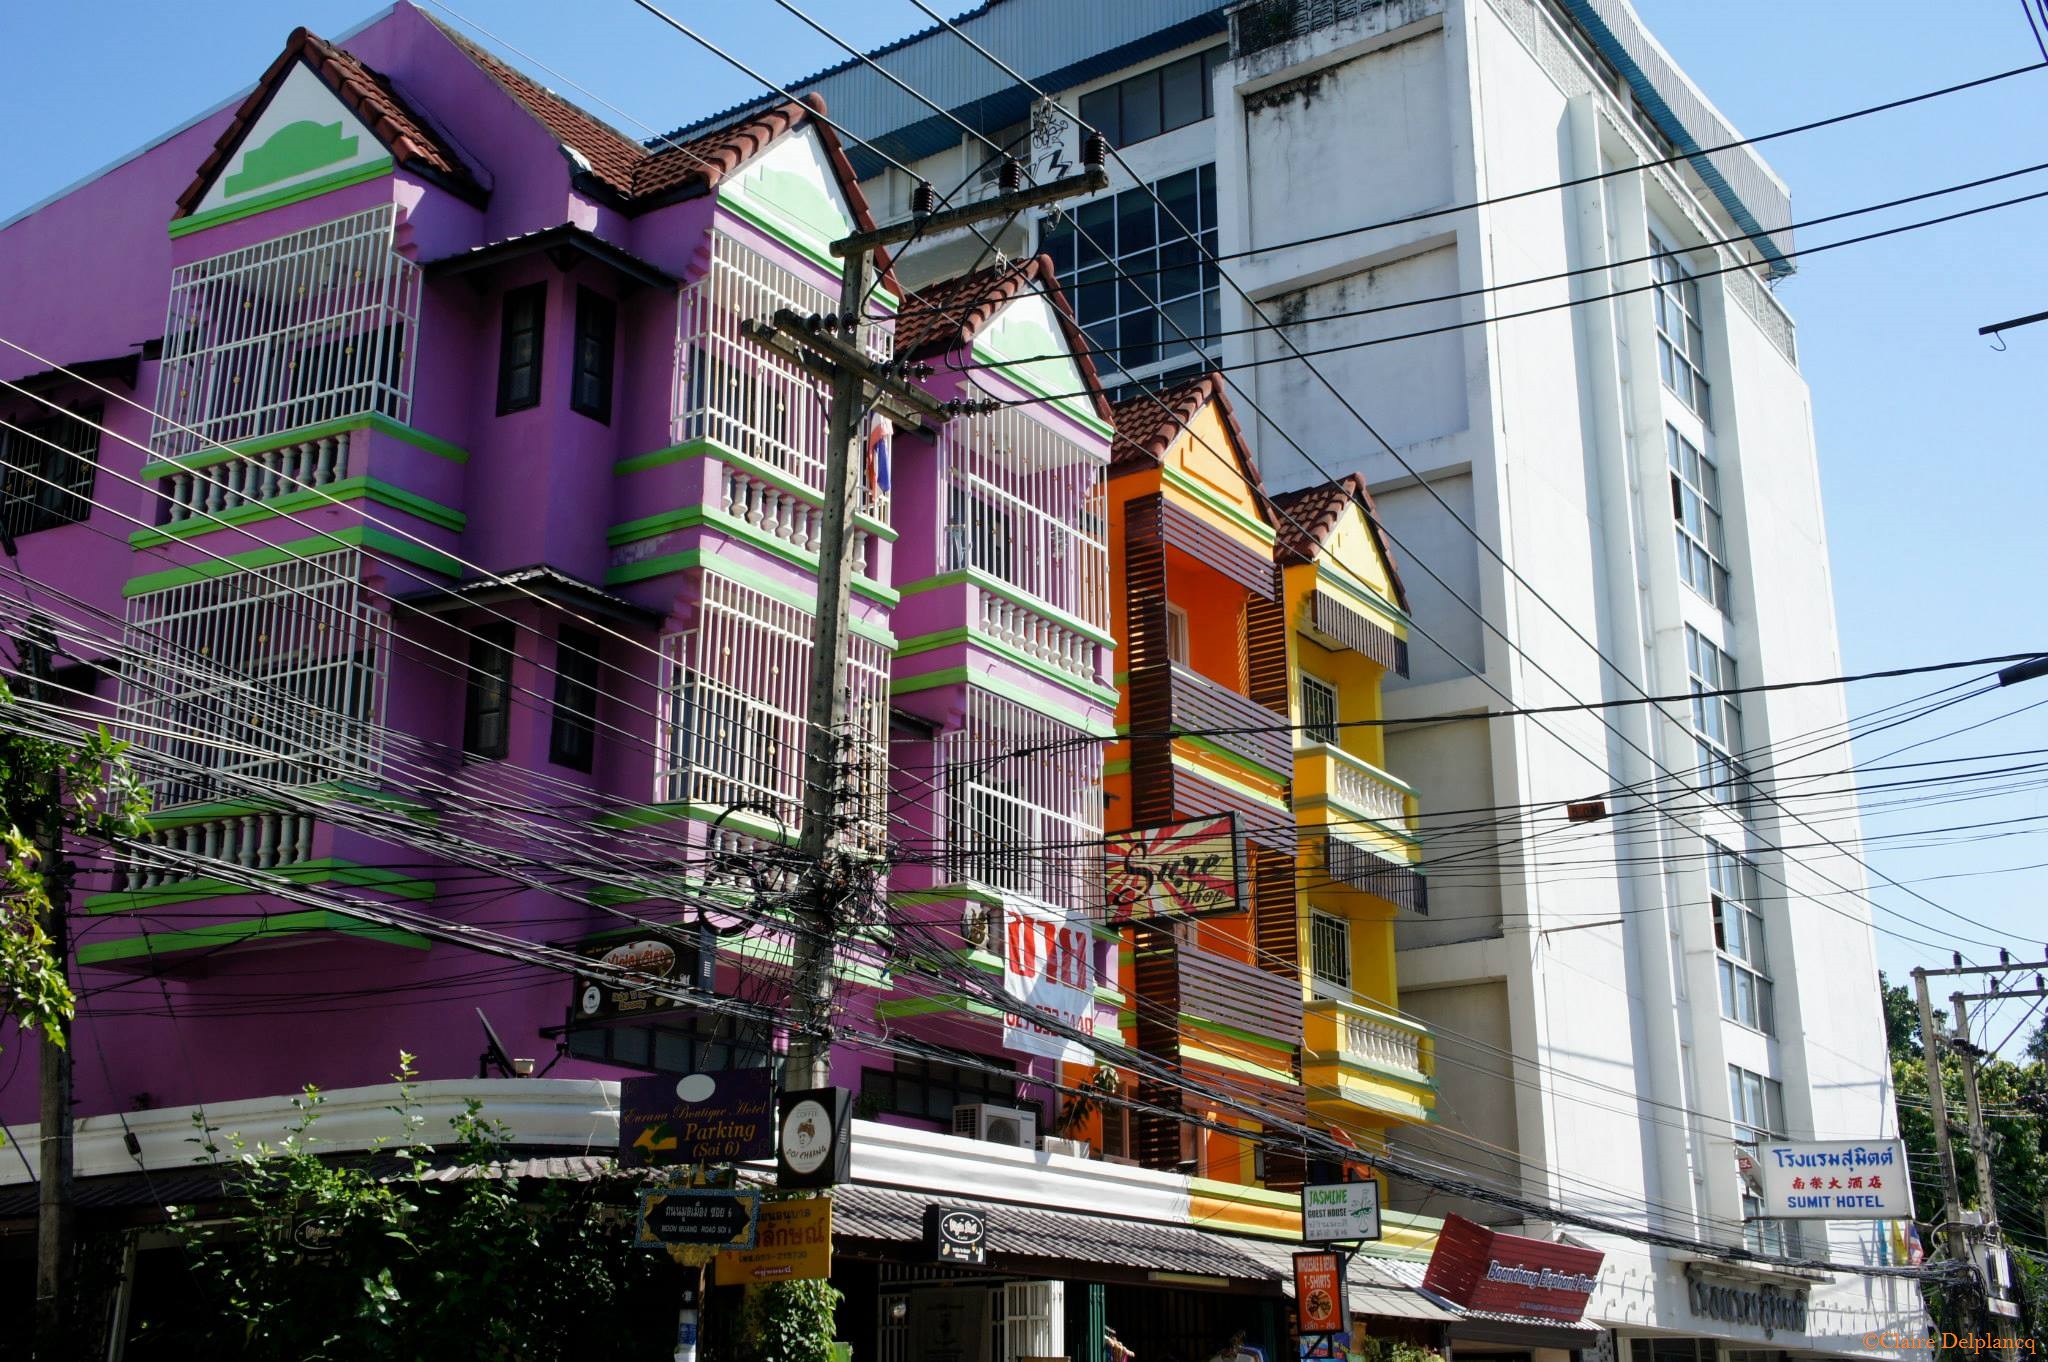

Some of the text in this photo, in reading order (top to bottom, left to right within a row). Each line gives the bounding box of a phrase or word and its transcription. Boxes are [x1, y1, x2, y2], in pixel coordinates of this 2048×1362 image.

[1008, 911, 1087, 990] ขาย
[673, 1103, 728, 1122] Boutique
[735, 1099, 768, 1115] Hotel
[683, 1120, 758, 1142] Parking
[692, 1140, 740, 1158] (Soi 6)
[1772, 1146, 1894, 1172] โรงแรมสุมิตต์
[1308, 1188, 1348, 1207] JASMINE
[1787, 1195, 1885, 1209] SUMIT HOTEL
[1307, 1208, 1347, 1218] GUEST HOUSE
[1304, 1274, 1331, 1289] T-SHIRTS
[1487, 1259, 1540, 1290] Baanchang
[1539, 1267, 1578, 1292] Elephant
